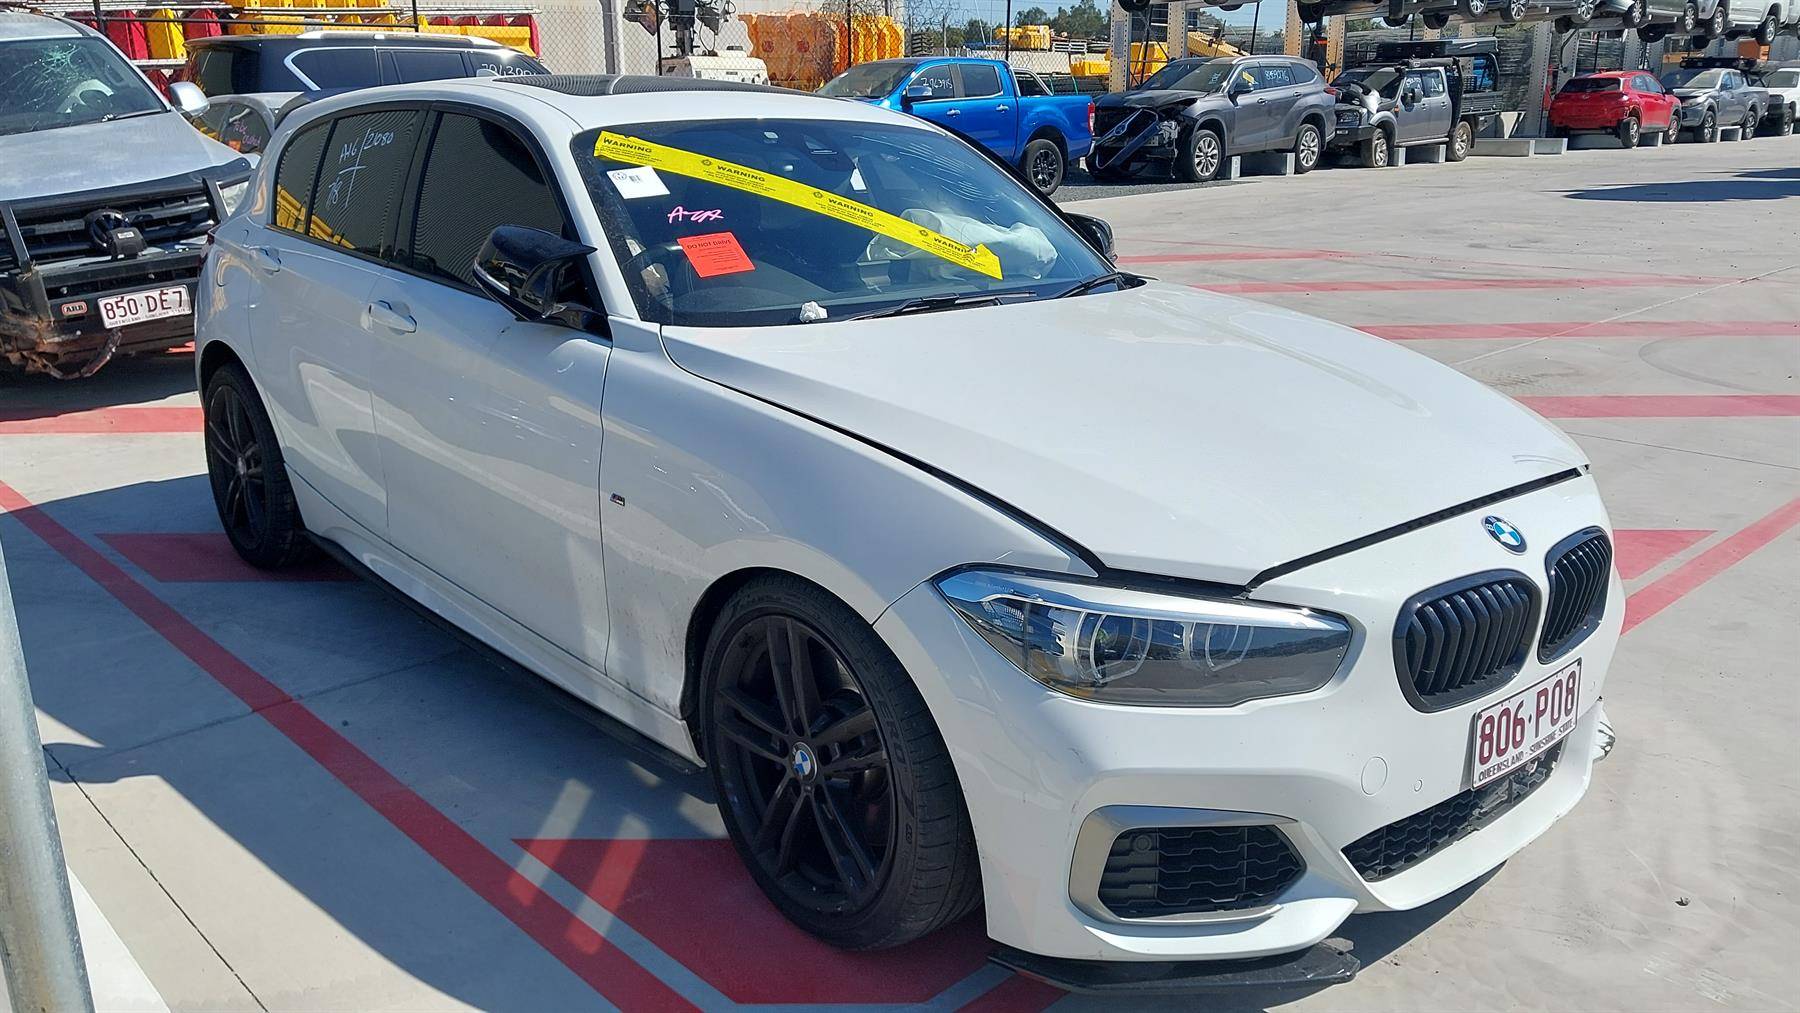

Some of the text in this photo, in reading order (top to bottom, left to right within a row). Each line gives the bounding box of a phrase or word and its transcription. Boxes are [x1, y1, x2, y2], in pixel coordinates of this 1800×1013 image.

[602, 137, 653, 153] WARNING
[717, 165, 765, 182] WARNING
[828, 198, 873, 217] WARNING
[1478, 750, 1525, 782] QUEENSLAND
[1558, 718, 1574, 734] STATE
